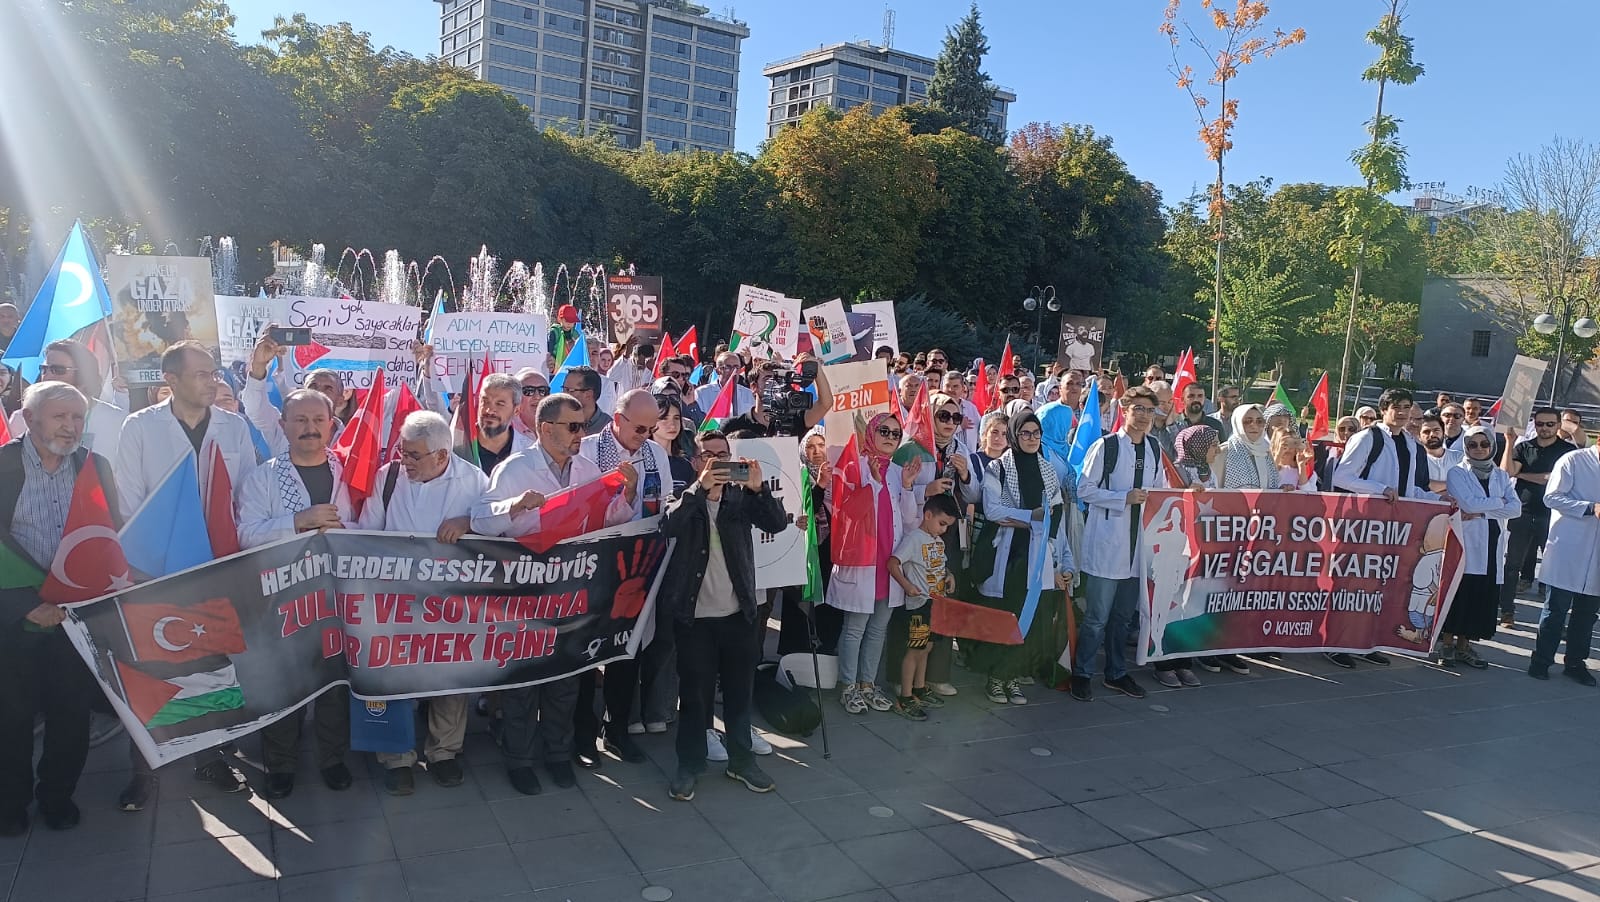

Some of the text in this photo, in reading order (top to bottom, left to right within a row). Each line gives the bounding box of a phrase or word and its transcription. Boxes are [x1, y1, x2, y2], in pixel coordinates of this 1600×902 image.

[1410, 181, 1446, 190] YSTEM
[130, 276, 193, 300] GAZA
[288, 300, 365, 328] Seni yok
[611, 294, 658, 322] 365
[227, 315, 270, 338] GAZ
[355, 315, 418, 339] sayacaklar
[446, 318, 536, 337] ADIM ATMAYI
[494, 340, 542, 354] BEBEKLER
[140, 369, 161, 381] FREE
[386, 355, 415, 372] daha
[850, 384, 873, 409] BİN
[1200, 509, 1412, 546] TERÖR, SOYKIRIM
[260, 550, 599, 596] HEKİMLERDEN SESSİZ YÜRÜYÜŞ
[1204, 546, 1400, 586] VE İŞGALE KARŞI
[373, 592, 416, 625] VE
[422, 588, 589, 625] SOYKIRIMA
[1207, 589, 1384, 616] HEKİMLERDEN SESSİZ YÜRÜYÜŞ
[613, 629, 633, 646] KA
[1275, 619, 1313, 637] KAYSERİ
[321, 621, 558, 669] DR DEMEK İÇİN!
